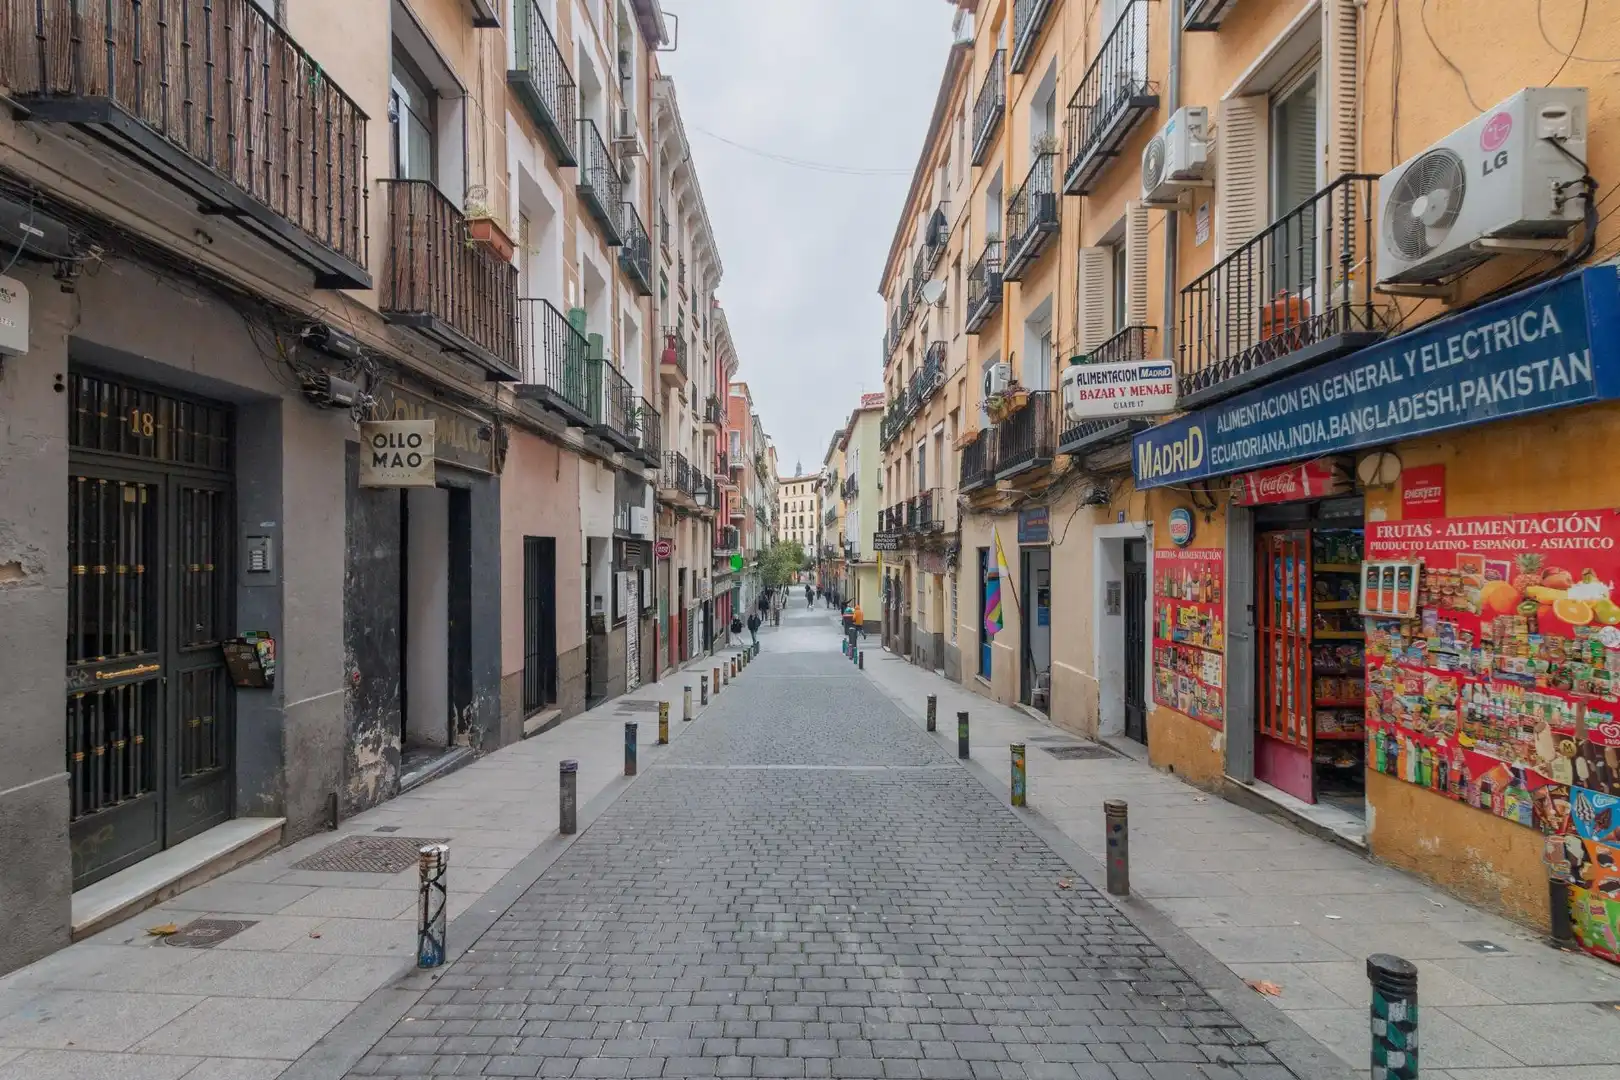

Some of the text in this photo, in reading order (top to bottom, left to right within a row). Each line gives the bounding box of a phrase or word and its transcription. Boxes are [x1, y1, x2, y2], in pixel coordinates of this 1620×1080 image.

[1482, 150, 1508, 177] LG
[1077, 368, 1137, 387] ALIMENTACION
[1217, 305, 1562, 433] ALIMENTACION EN GENERAL Y ELECTRICA
[1080, 384, 1172, 400] BAZAR Y MENAJE
[132, 408, 154, 436] 18
[373, 433, 422, 448] OLLO
[372, 452, 422, 468] MAO
[1138, 426, 1203, 480] MADRID
[1376, 523, 1432, 538] FRUTAS
[1445, 512, 1602, 537] ALIMENTACIÓN
[1370, 540, 1423, 550] PRODUCTO
[1473, 537, 1529, 549] ESPAÑOL
[1540, 537, 1614, 549] ASIATICO
